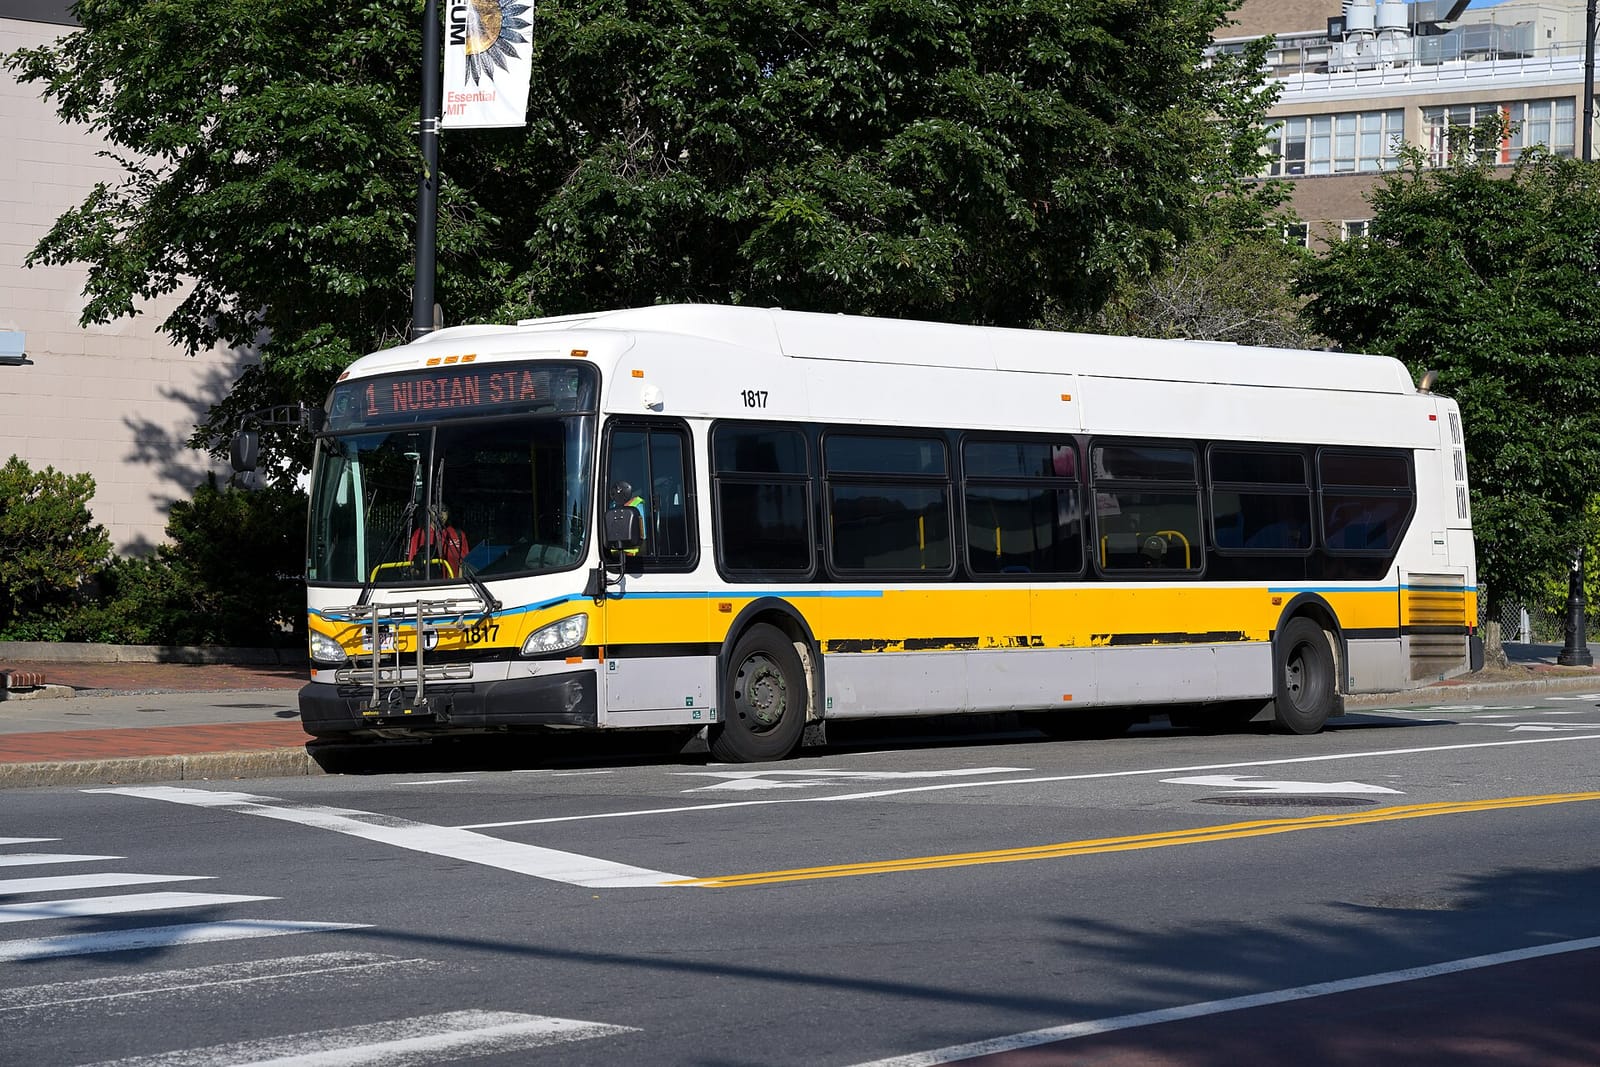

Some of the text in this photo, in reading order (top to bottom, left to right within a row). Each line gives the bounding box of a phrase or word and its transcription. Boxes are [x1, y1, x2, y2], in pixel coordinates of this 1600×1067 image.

[447, 91, 496, 103] Essential
[447, 104, 467, 116] MIT
[366, 371, 536, 414] 1 NUBIAN STA
[741, 389, 768, 408] 1817
[463, 624, 500, 644] 1817
